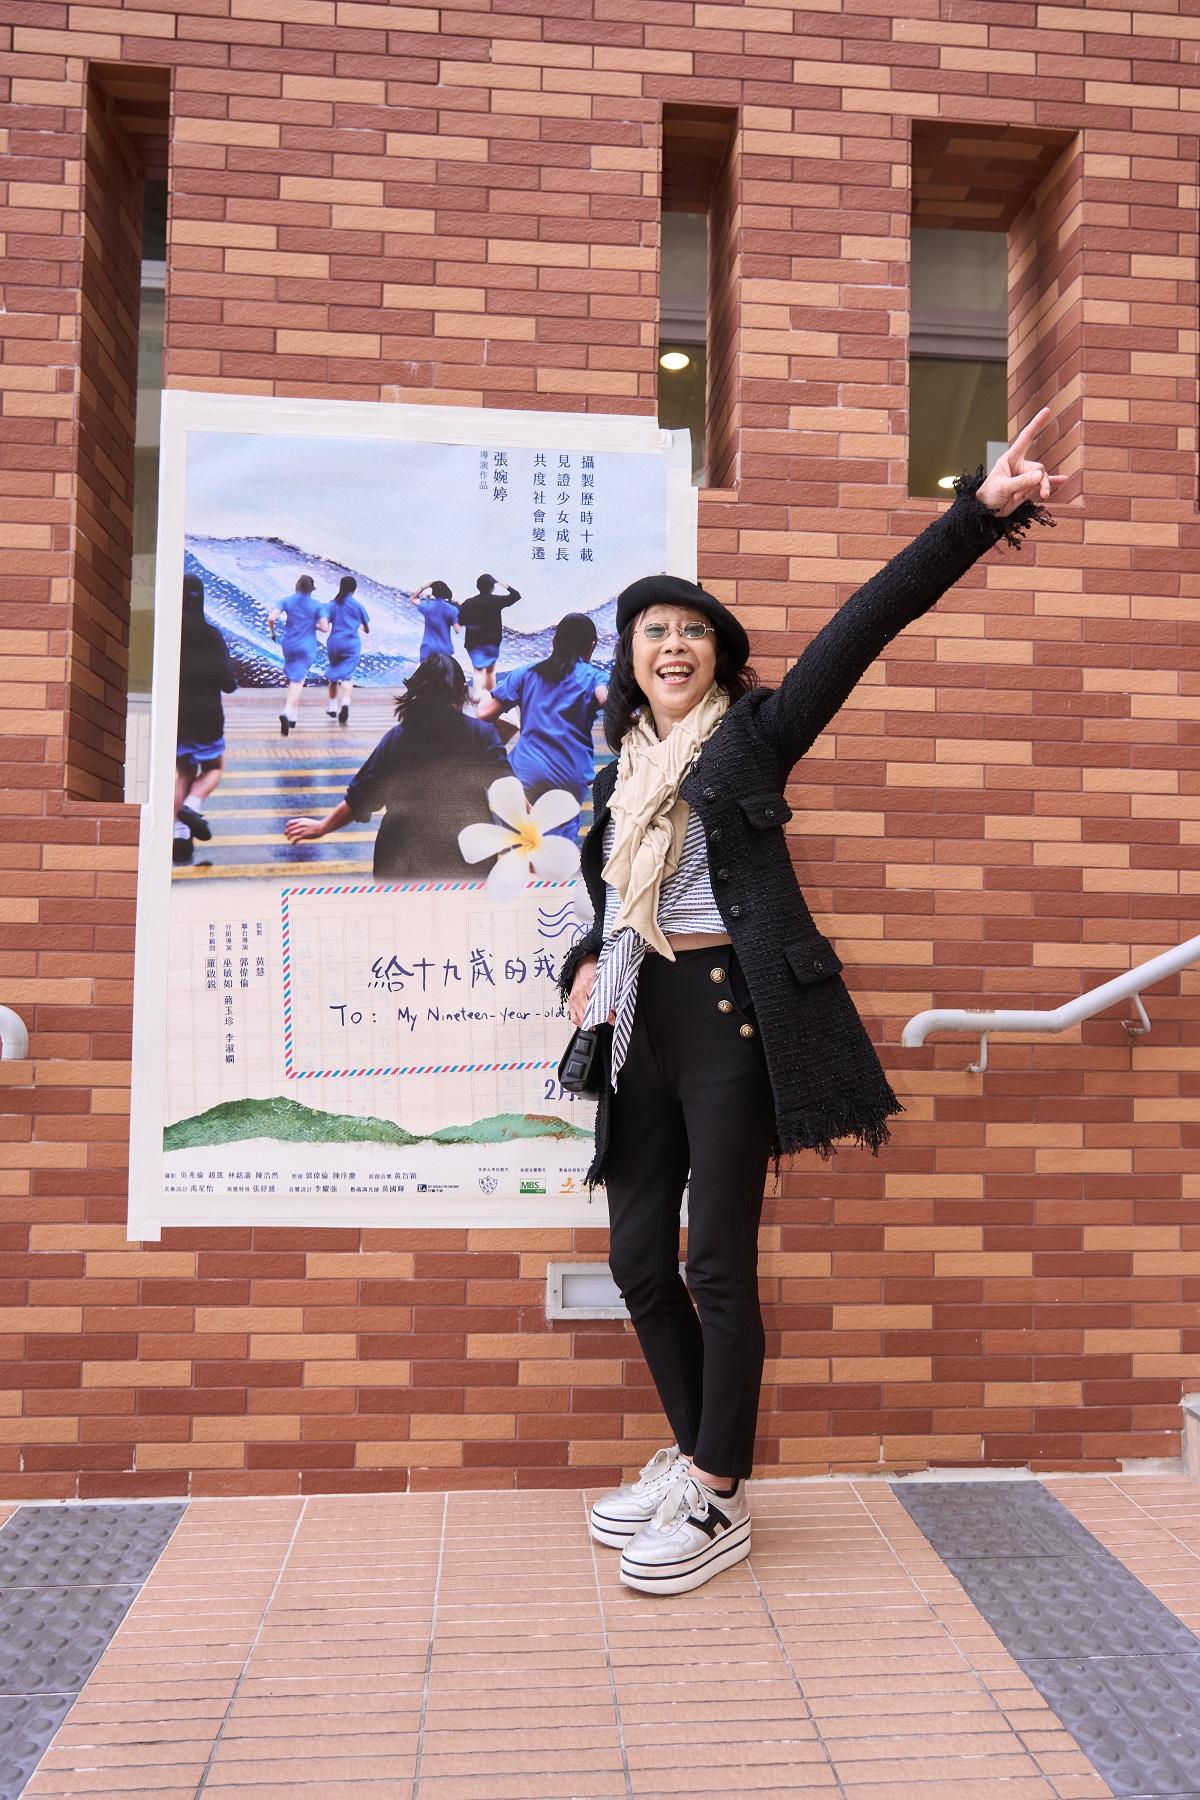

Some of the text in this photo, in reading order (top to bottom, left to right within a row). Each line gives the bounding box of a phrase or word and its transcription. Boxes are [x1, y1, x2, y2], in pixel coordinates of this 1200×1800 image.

[479, 450, 489, 490] 導演作品
[493, 451, 509, 502] 張婉婷
[531, 453, 547, 560] 共度社會變遷
[556, 454, 571, 561] 見證少女成長
[580, 455, 595, 562] 攝製歷時十載
[367, 947, 560, 993] 給十九歲的我
[397, 1006, 418, 1032] My
[521, 1181, 539, 1189] MBS
